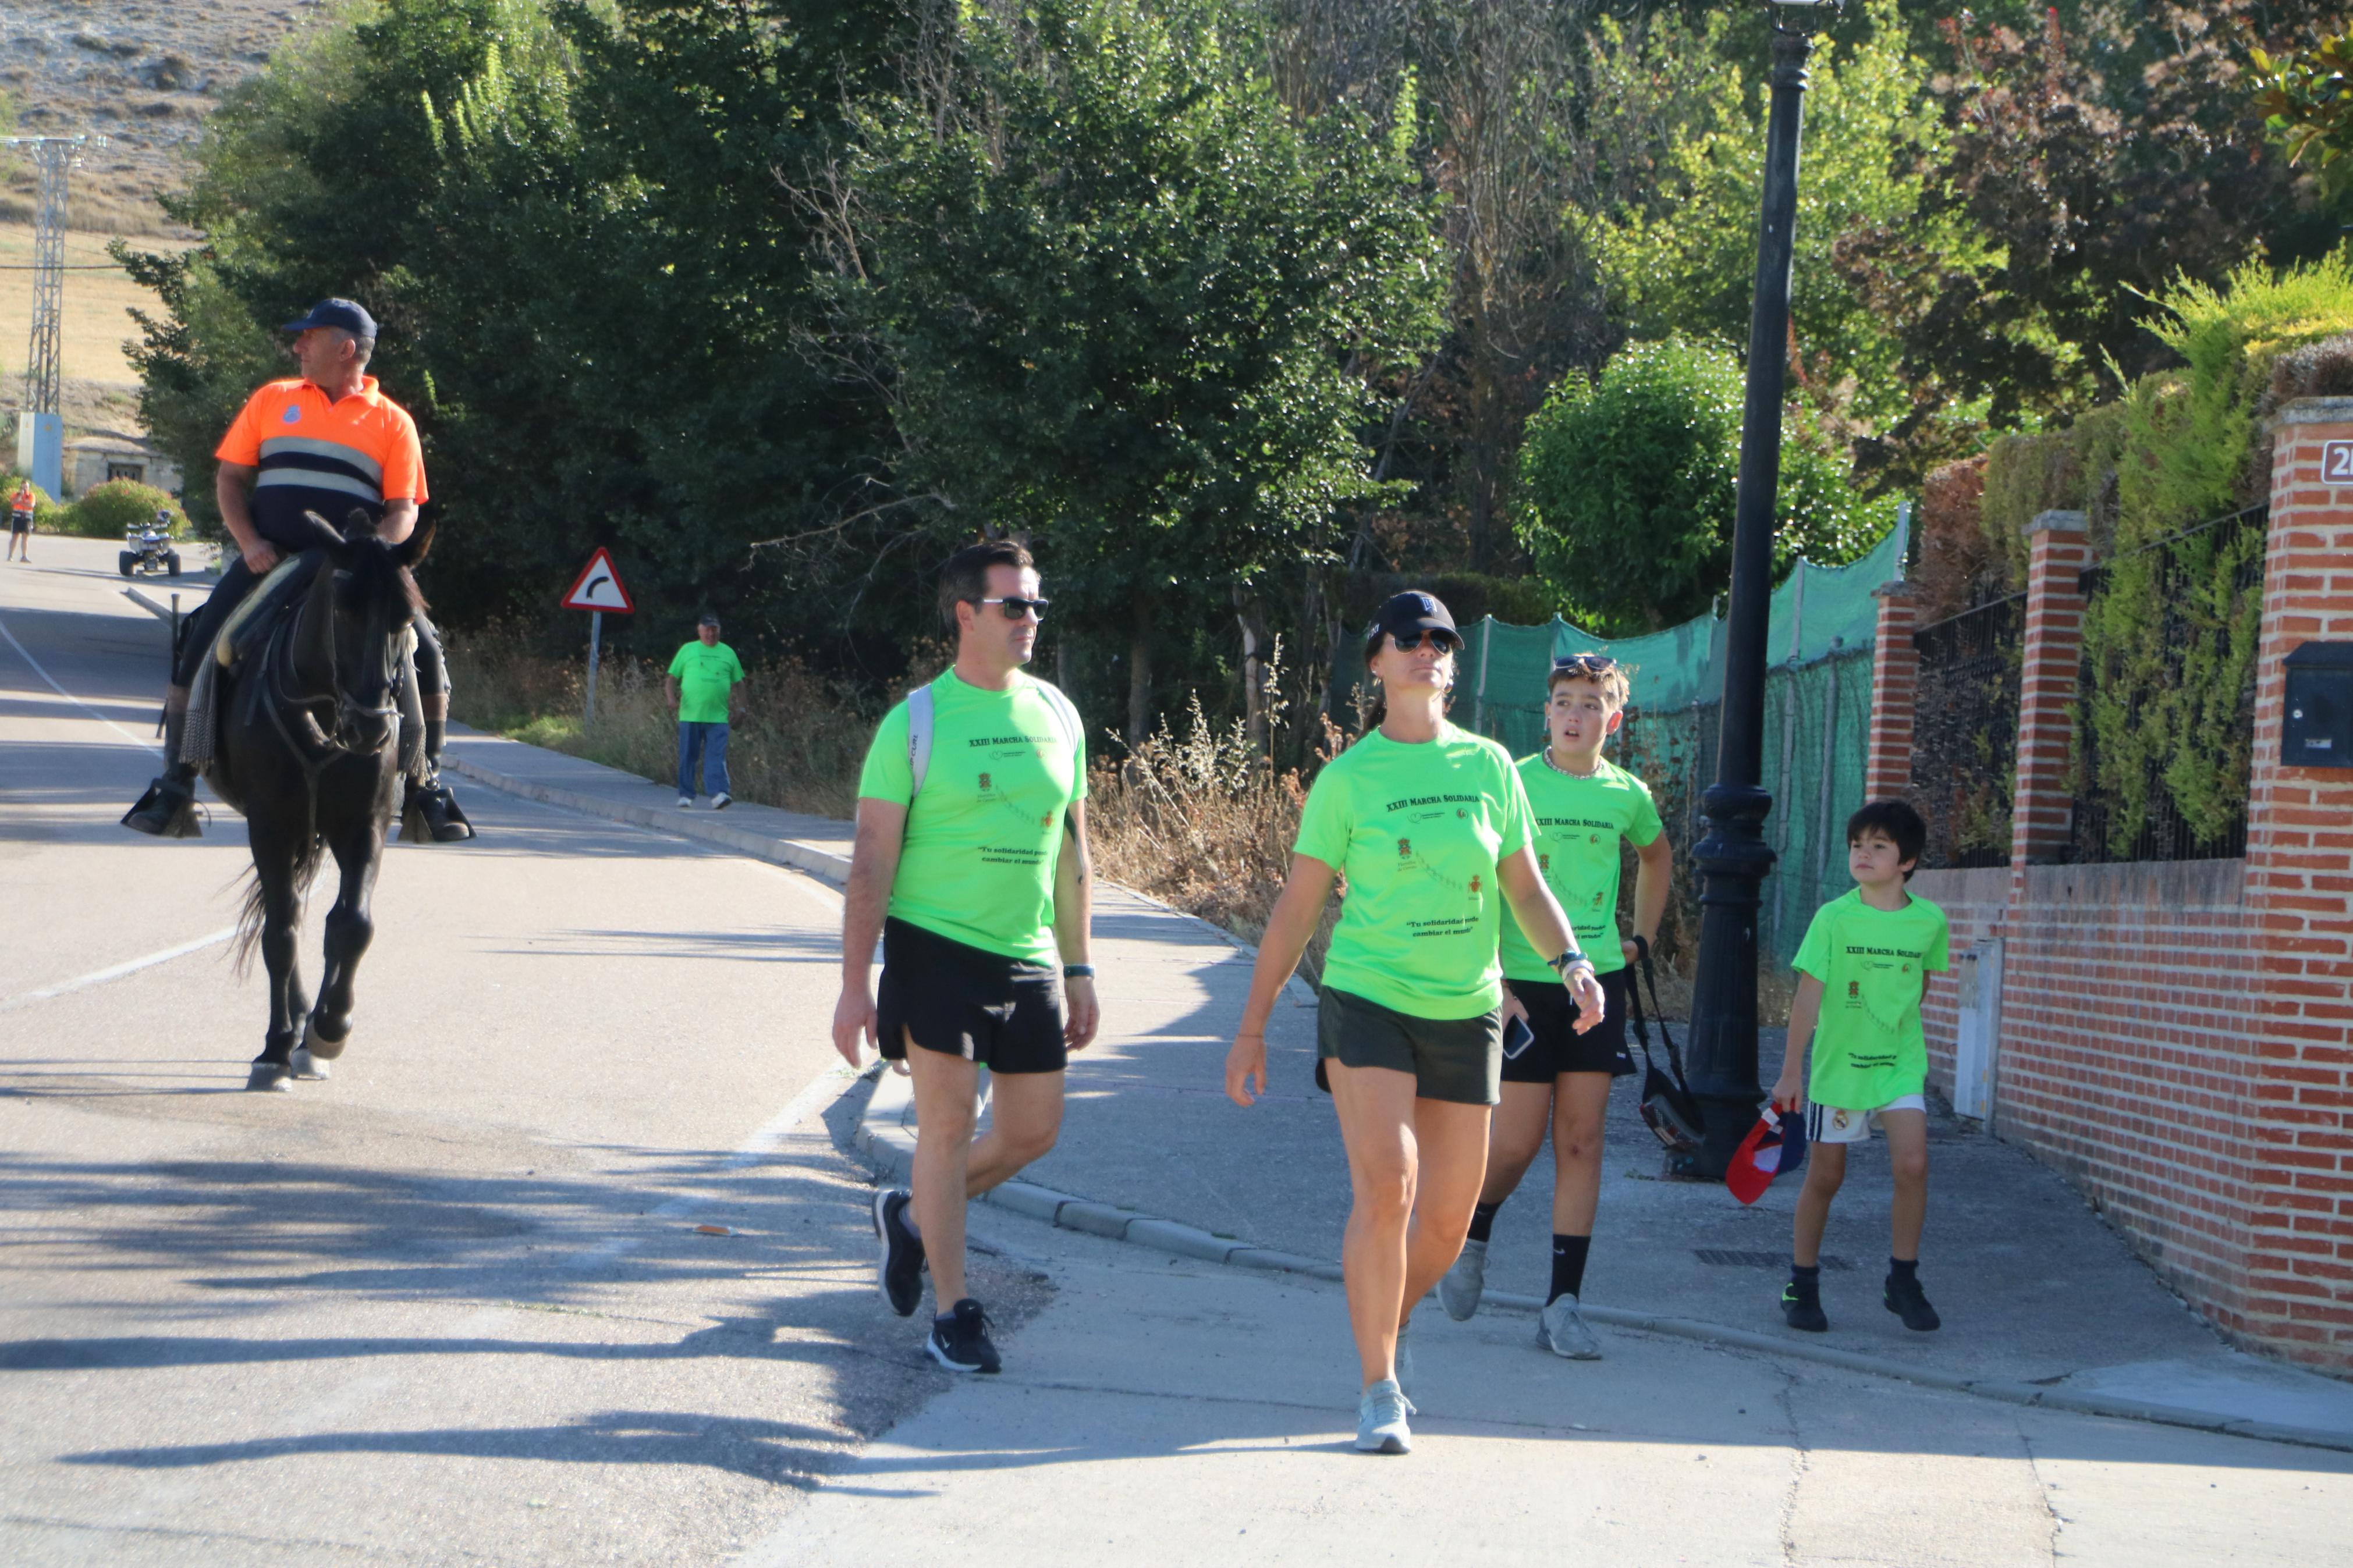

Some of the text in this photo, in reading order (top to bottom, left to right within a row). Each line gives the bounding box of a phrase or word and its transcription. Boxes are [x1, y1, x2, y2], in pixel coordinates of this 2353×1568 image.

[969, 738, 990, 747] XXIII
[992, 737, 1023, 745] MARCHA
[1386, 795, 1480, 812] XXIII MARCHA SOLIDARIA
[1555, 818, 1580, 826] MARCHA
[1582, 819, 1614, 830] SOLIDARIA
[1412, 929, 1443, 937] cambiar
[1846, 946, 1864, 954] XXIII
[1866, 947, 1894, 956] MARCHA
